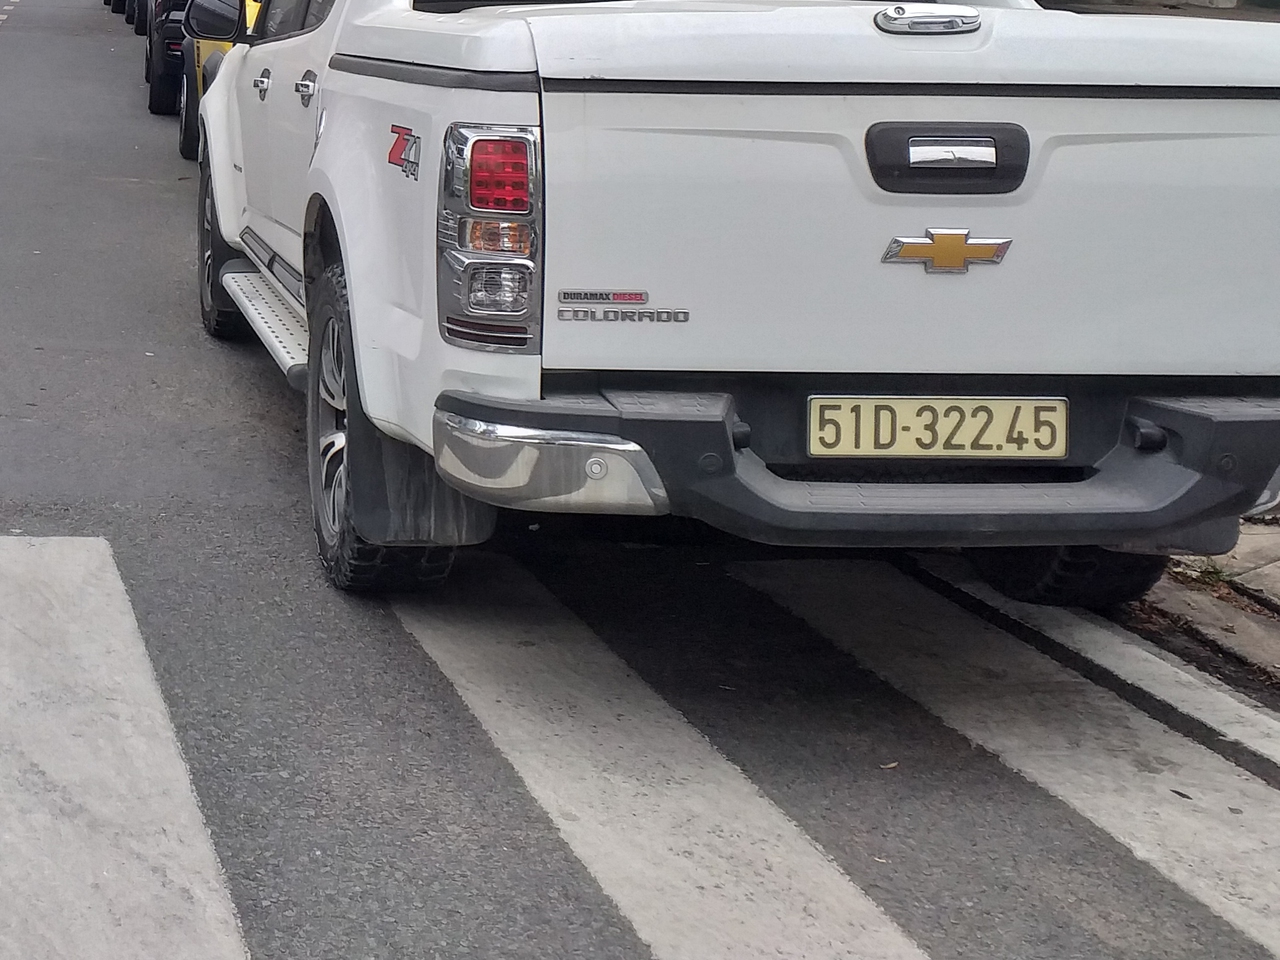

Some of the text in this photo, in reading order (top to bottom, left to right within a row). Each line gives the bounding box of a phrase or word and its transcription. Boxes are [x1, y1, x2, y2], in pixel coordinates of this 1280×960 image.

[563, 292, 645, 302] DURAMAX DIESEL
[557, 307, 690, 323] COLORADO
[818, 403, 1058, 451] 51D-322.45
